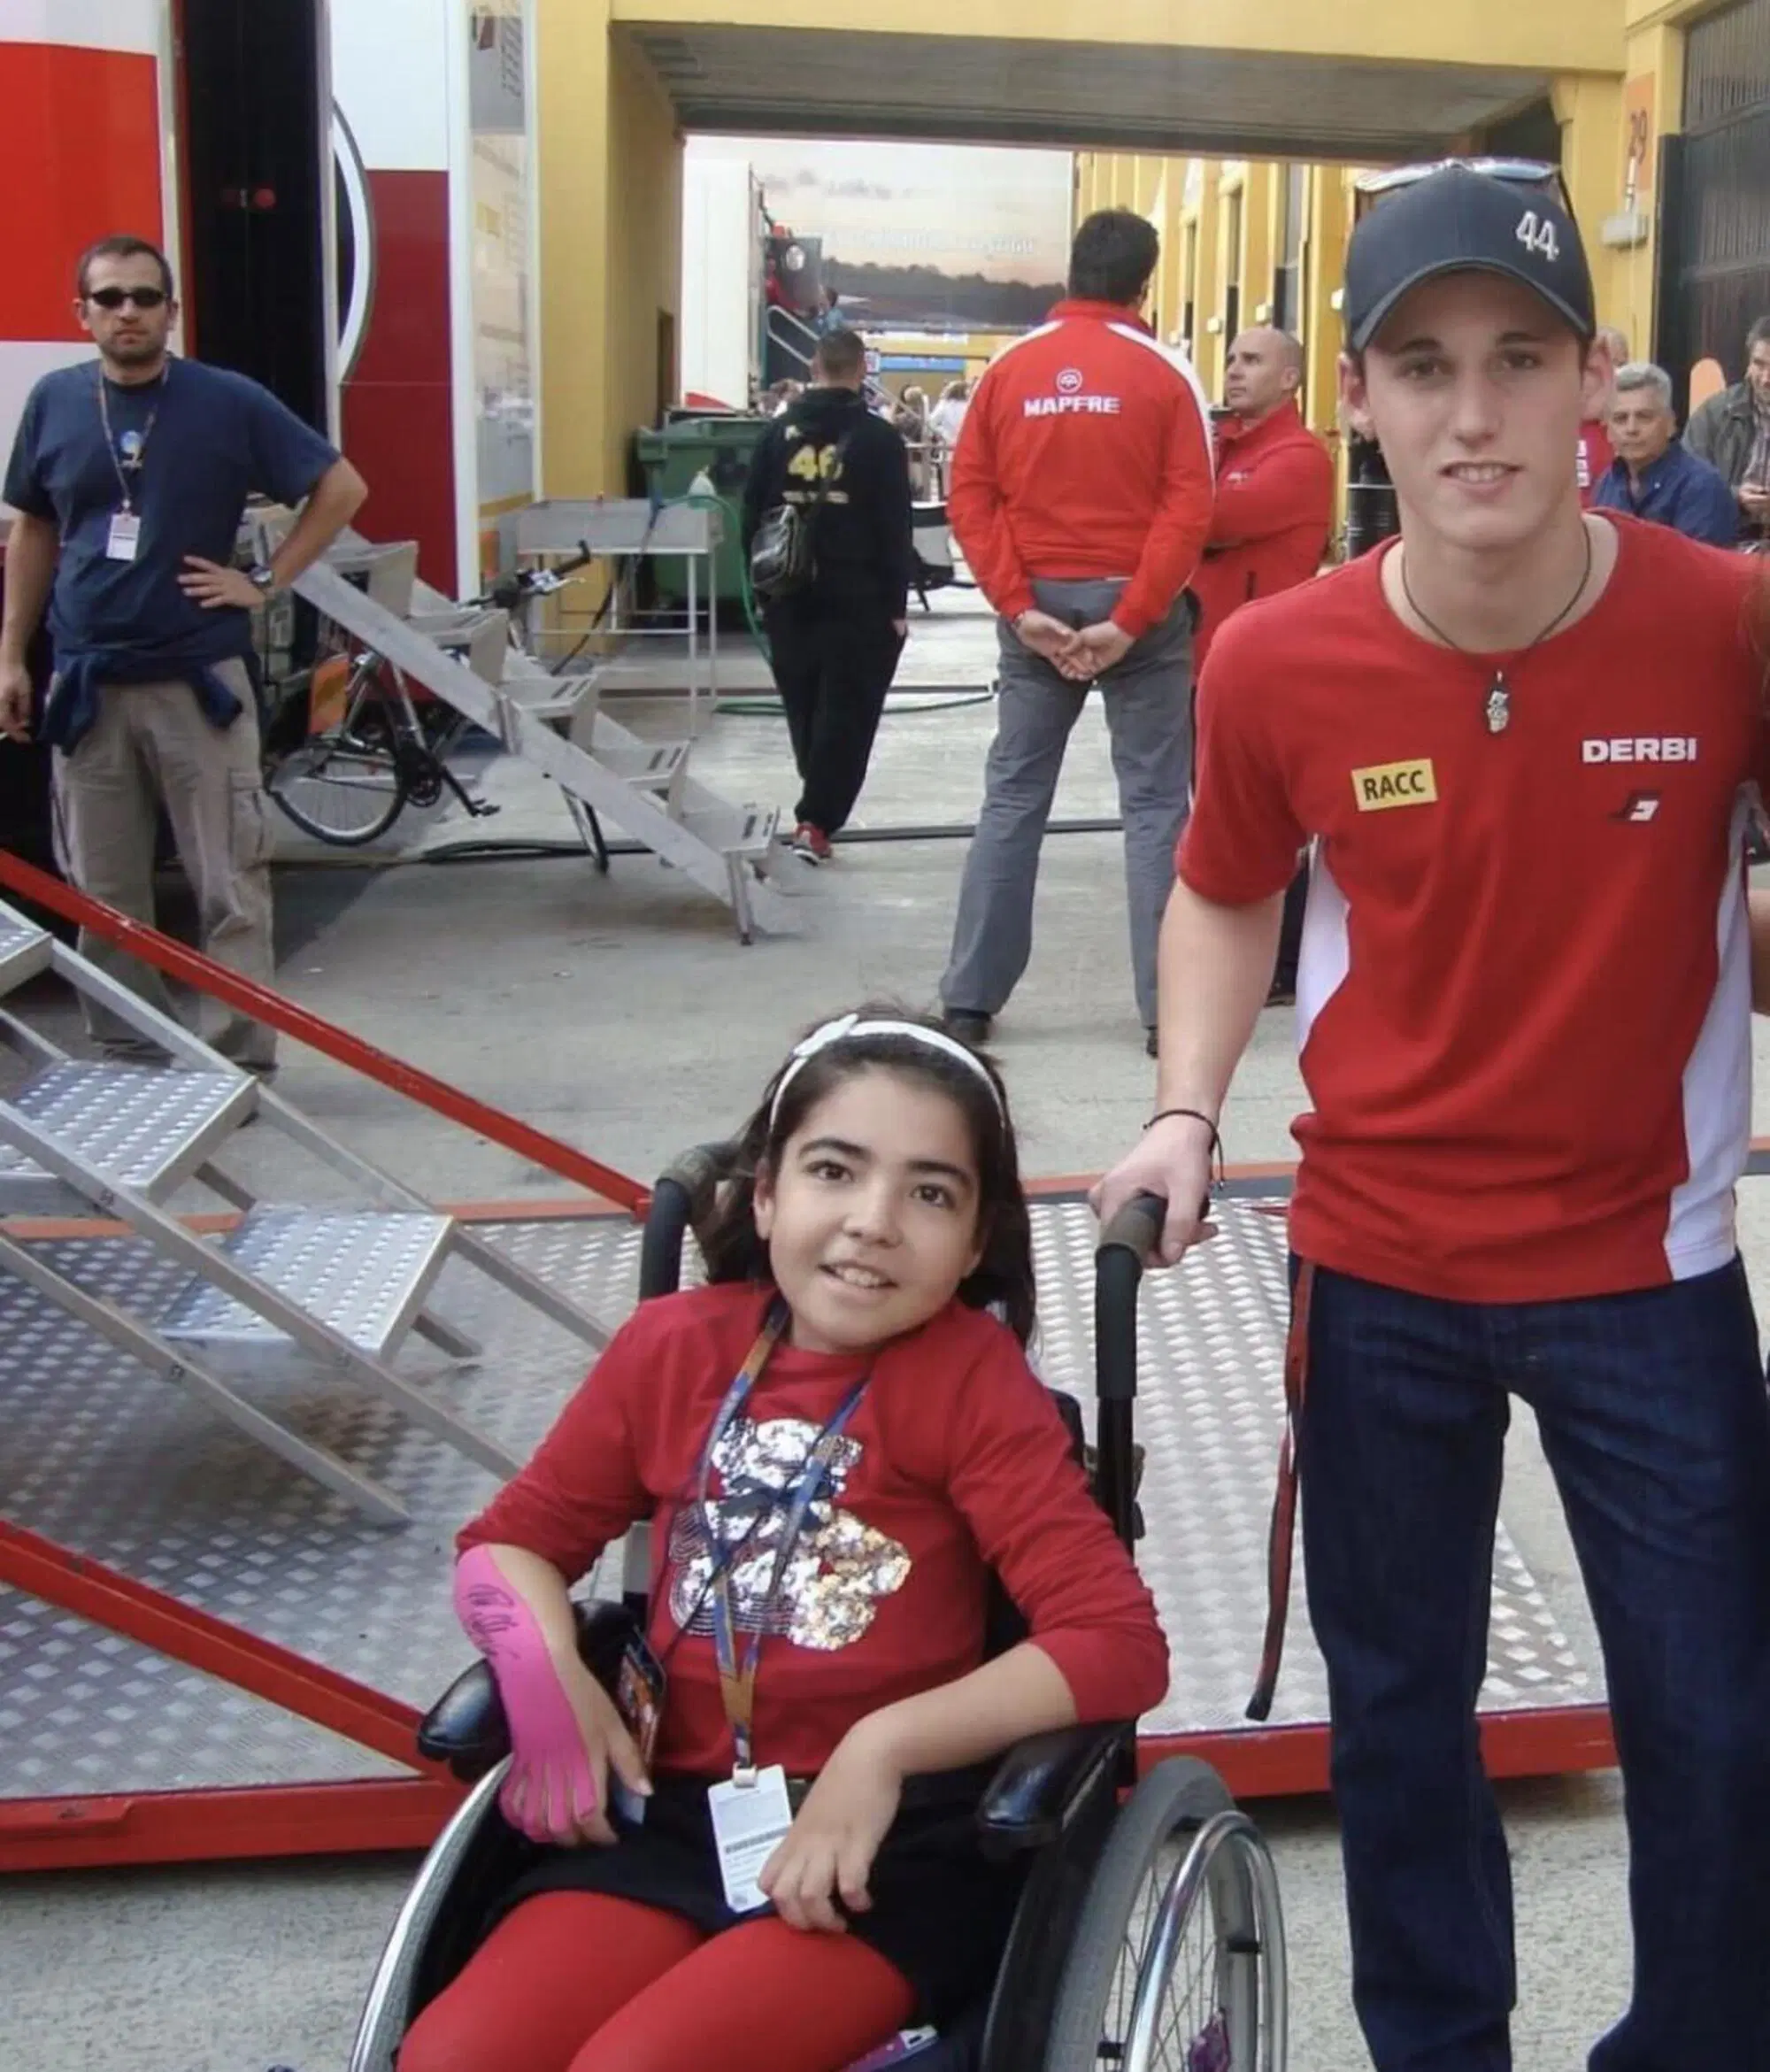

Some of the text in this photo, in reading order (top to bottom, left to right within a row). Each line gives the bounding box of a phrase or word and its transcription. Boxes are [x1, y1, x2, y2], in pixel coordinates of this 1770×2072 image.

[1515, 209, 1559, 262] 44
[1023, 395, 1121, 419] MAPFRE
[1582, 737, 1697, 763] DERBI
[1363, 769, 1426, 802] RACC
